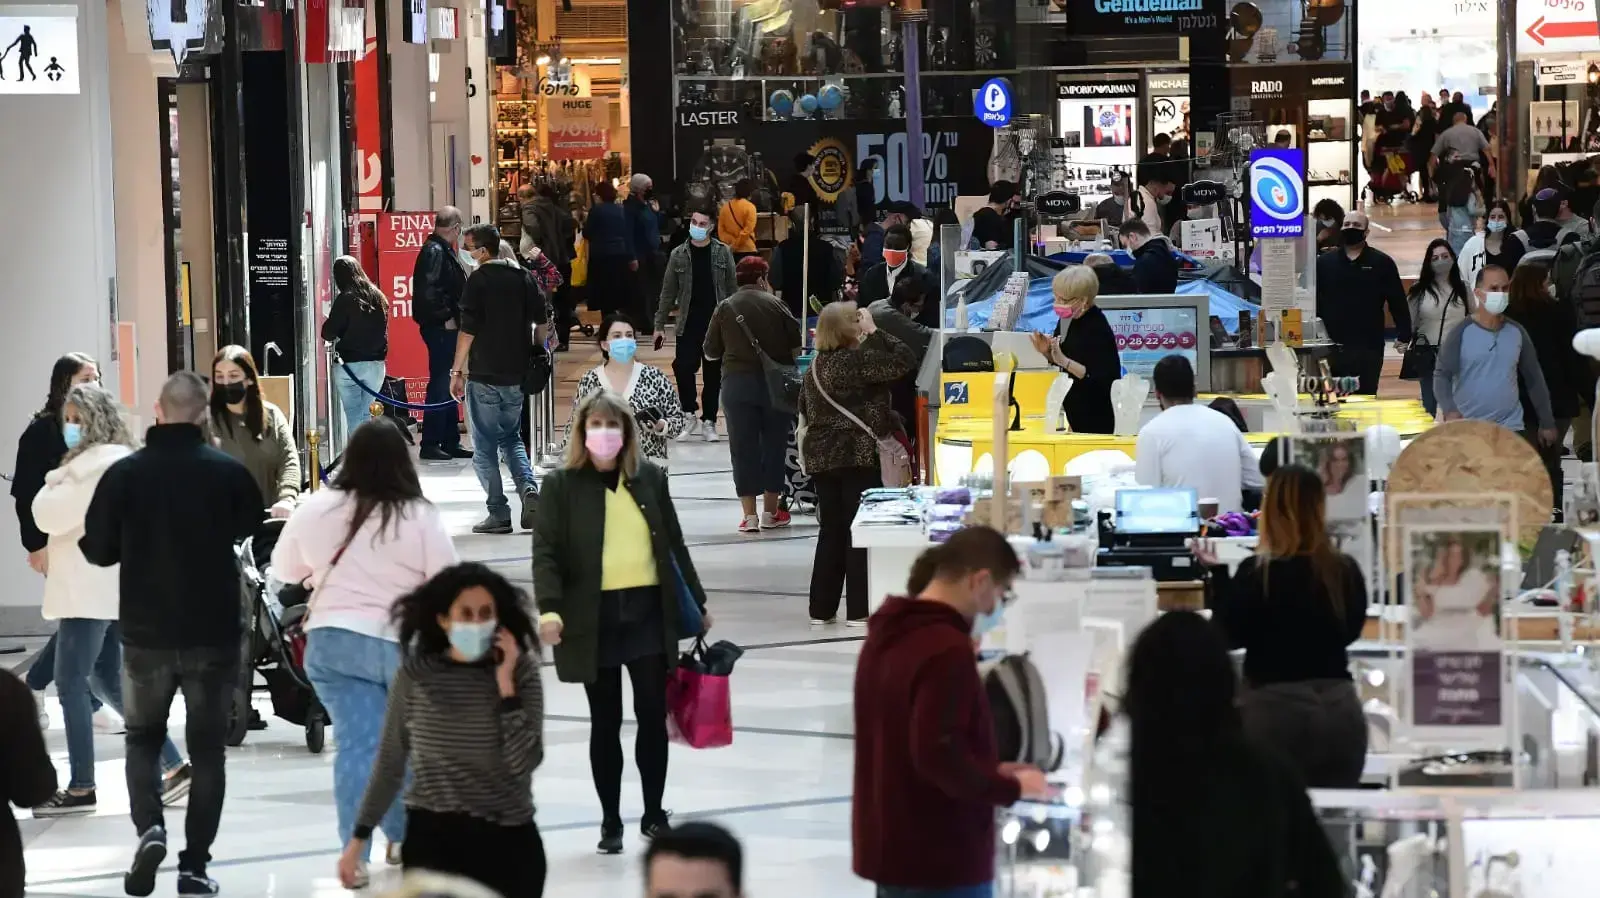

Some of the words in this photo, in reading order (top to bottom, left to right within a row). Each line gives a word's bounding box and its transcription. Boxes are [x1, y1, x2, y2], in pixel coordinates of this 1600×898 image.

[1251, 80, 1283, 93] RADO
[563, 100, 593, 109] HUGE
[681, 111, 738, 126] LASTER
[1045, 200, 1072, 208] MOYA
[1276, 224, 1302, 235] מפעל
[395, 232, 433, 248] SAL
[1129, 337, 1143, 346] 28
[1146, 337, 1159, 346] 22
[1162, 337, 1176, 345] 24
[1182, 336, 1190, 345] 5
